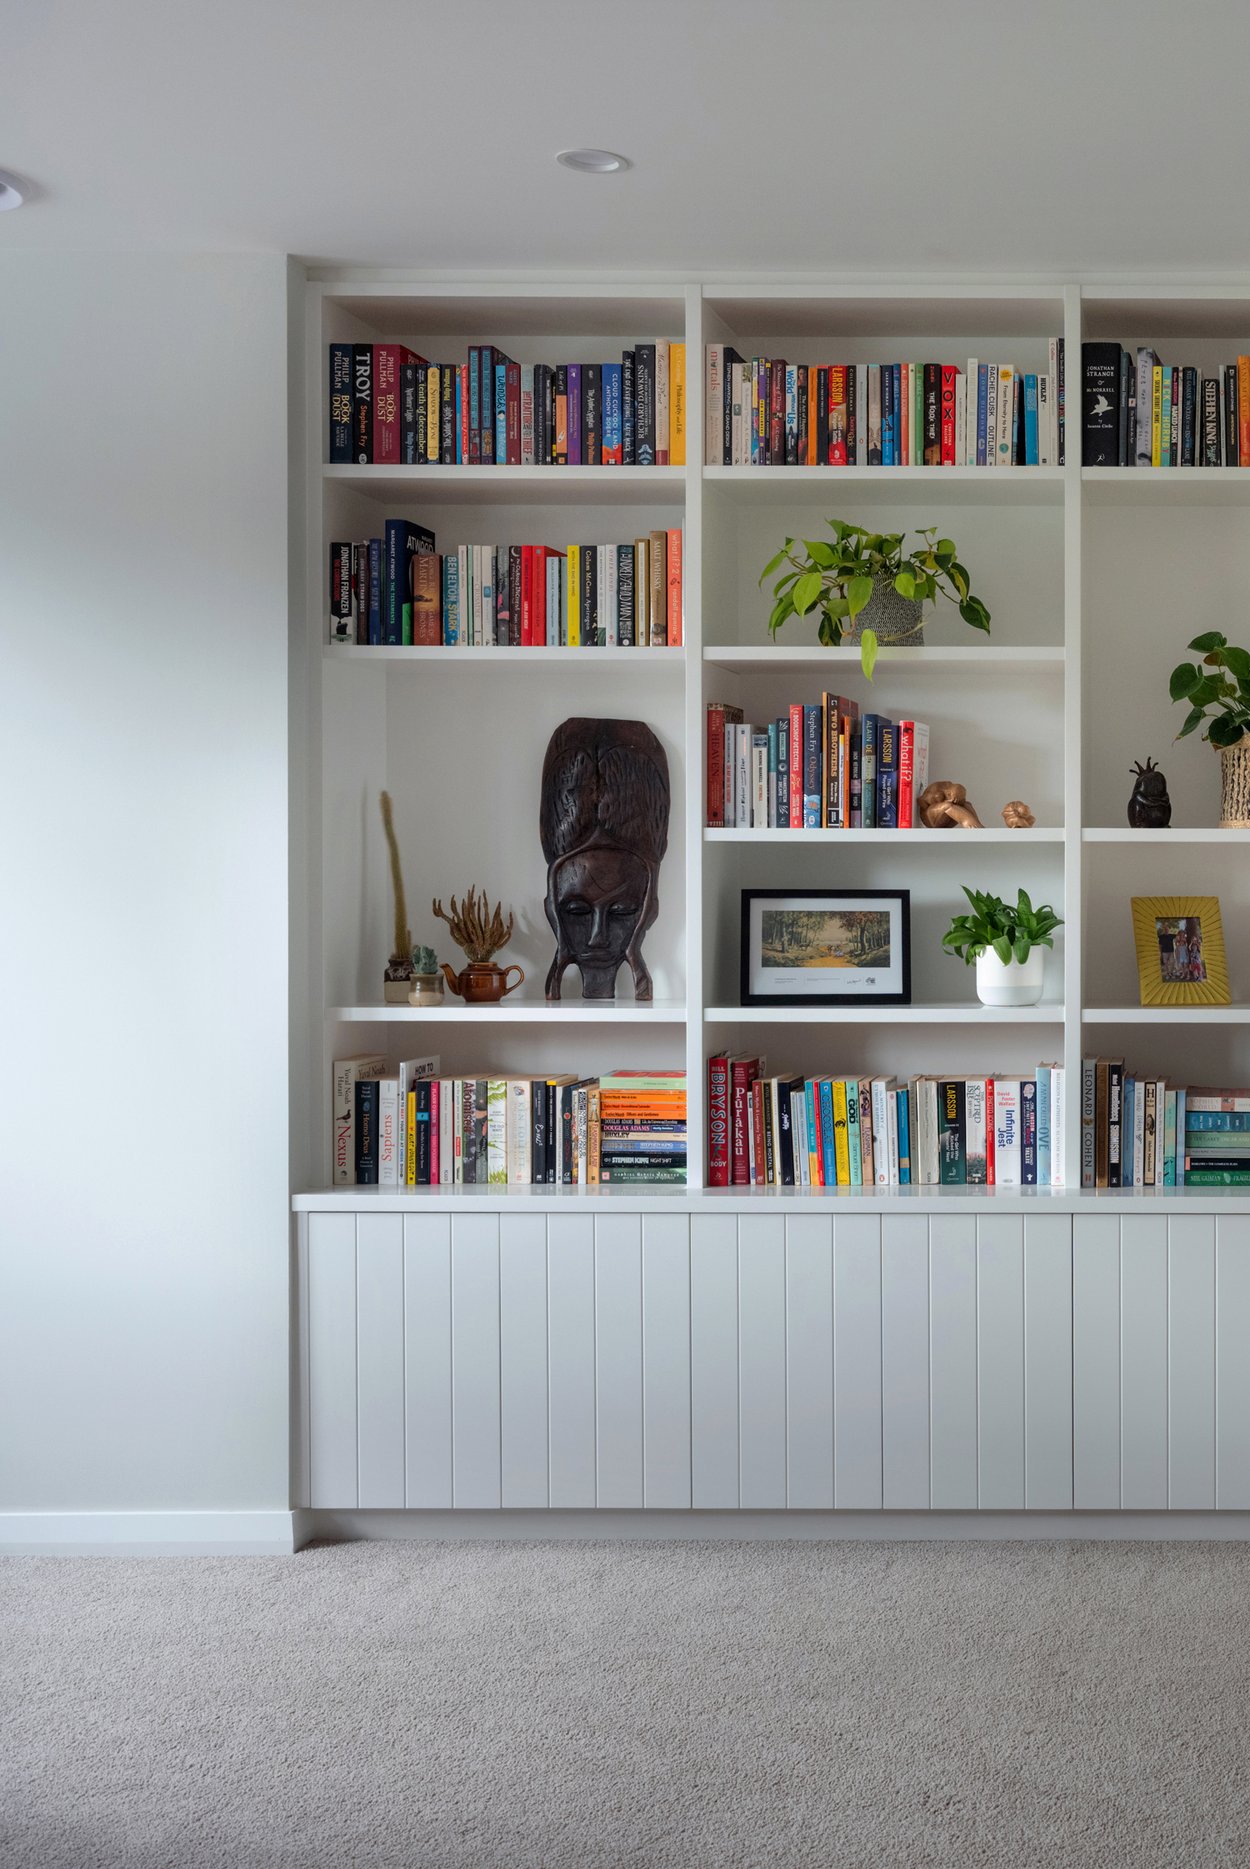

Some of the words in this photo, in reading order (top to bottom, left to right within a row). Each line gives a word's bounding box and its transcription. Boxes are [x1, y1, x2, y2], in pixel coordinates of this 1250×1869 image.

[334, 351, 342, 389] PULLMAN
[356, 353, 371, 402] TROY
[379, 351, 387, 389] PULLMAN
[386, 357, 394, 383] PHILIP
[417, 383, 426, 404] tenth
[832, 367, 843, 403] LARSSON
[943, 372, 953, 420] VOX
[332, 396, 341, 422] DUST
[341, 395, 350, 424] BOOK
[377, 396, 386, 421] DUST
[386, 394, 395, 424] BOOK
[416, 405, 426, 414] of
[1205, 381, 1217, 422] STEPHEN
[358, 405, 368, 434] Stephen
[787, 412, 796, 424] Us
[358, 436, 368, 448] Fry
[417, 415, 426, 454] december
[1205, 422, 1217, 444] KING
[341, 546, 349, 580] JONATHAN
[448, 557, 457, 574] BEN
[341, 581, 349, 613] FRANZEN
[448, 575, 457, 602] ELTON
[448, 604, 457, 631] STARK
[584, 598, 592, 630] Apeirogon
[808, 710, 817, 738] Stephen
[711, 733, 720, 777] HEAVEN
[808, 741, 816, 752] Fry
[866, 744, 872, 753] DE
[882, 729, 892, 763] LARSSON
[902, 736, 911, 764] what
[808, 756, 817, 790] Odyssey
[902, 766, 912, 781] if?
[946, 1084, 956, 1118] LARSSON
[1085, 1069, 1093, 1116] LEONARD
[710, 1073, 726, 1144] BRYSON
[848, 1099, 856, 1123] GOD
[382, 1114, 395, 1161] Sapiens
[998, 1127, 1006, 1147] Jest
[1006, 1109, 1015, 1144] Infinite
[1039, 1126, 1049, 1151] OVE
[338, 1126, 351, 1167] Nexus
[1085, 1133, 1093, 1167] COHEN
